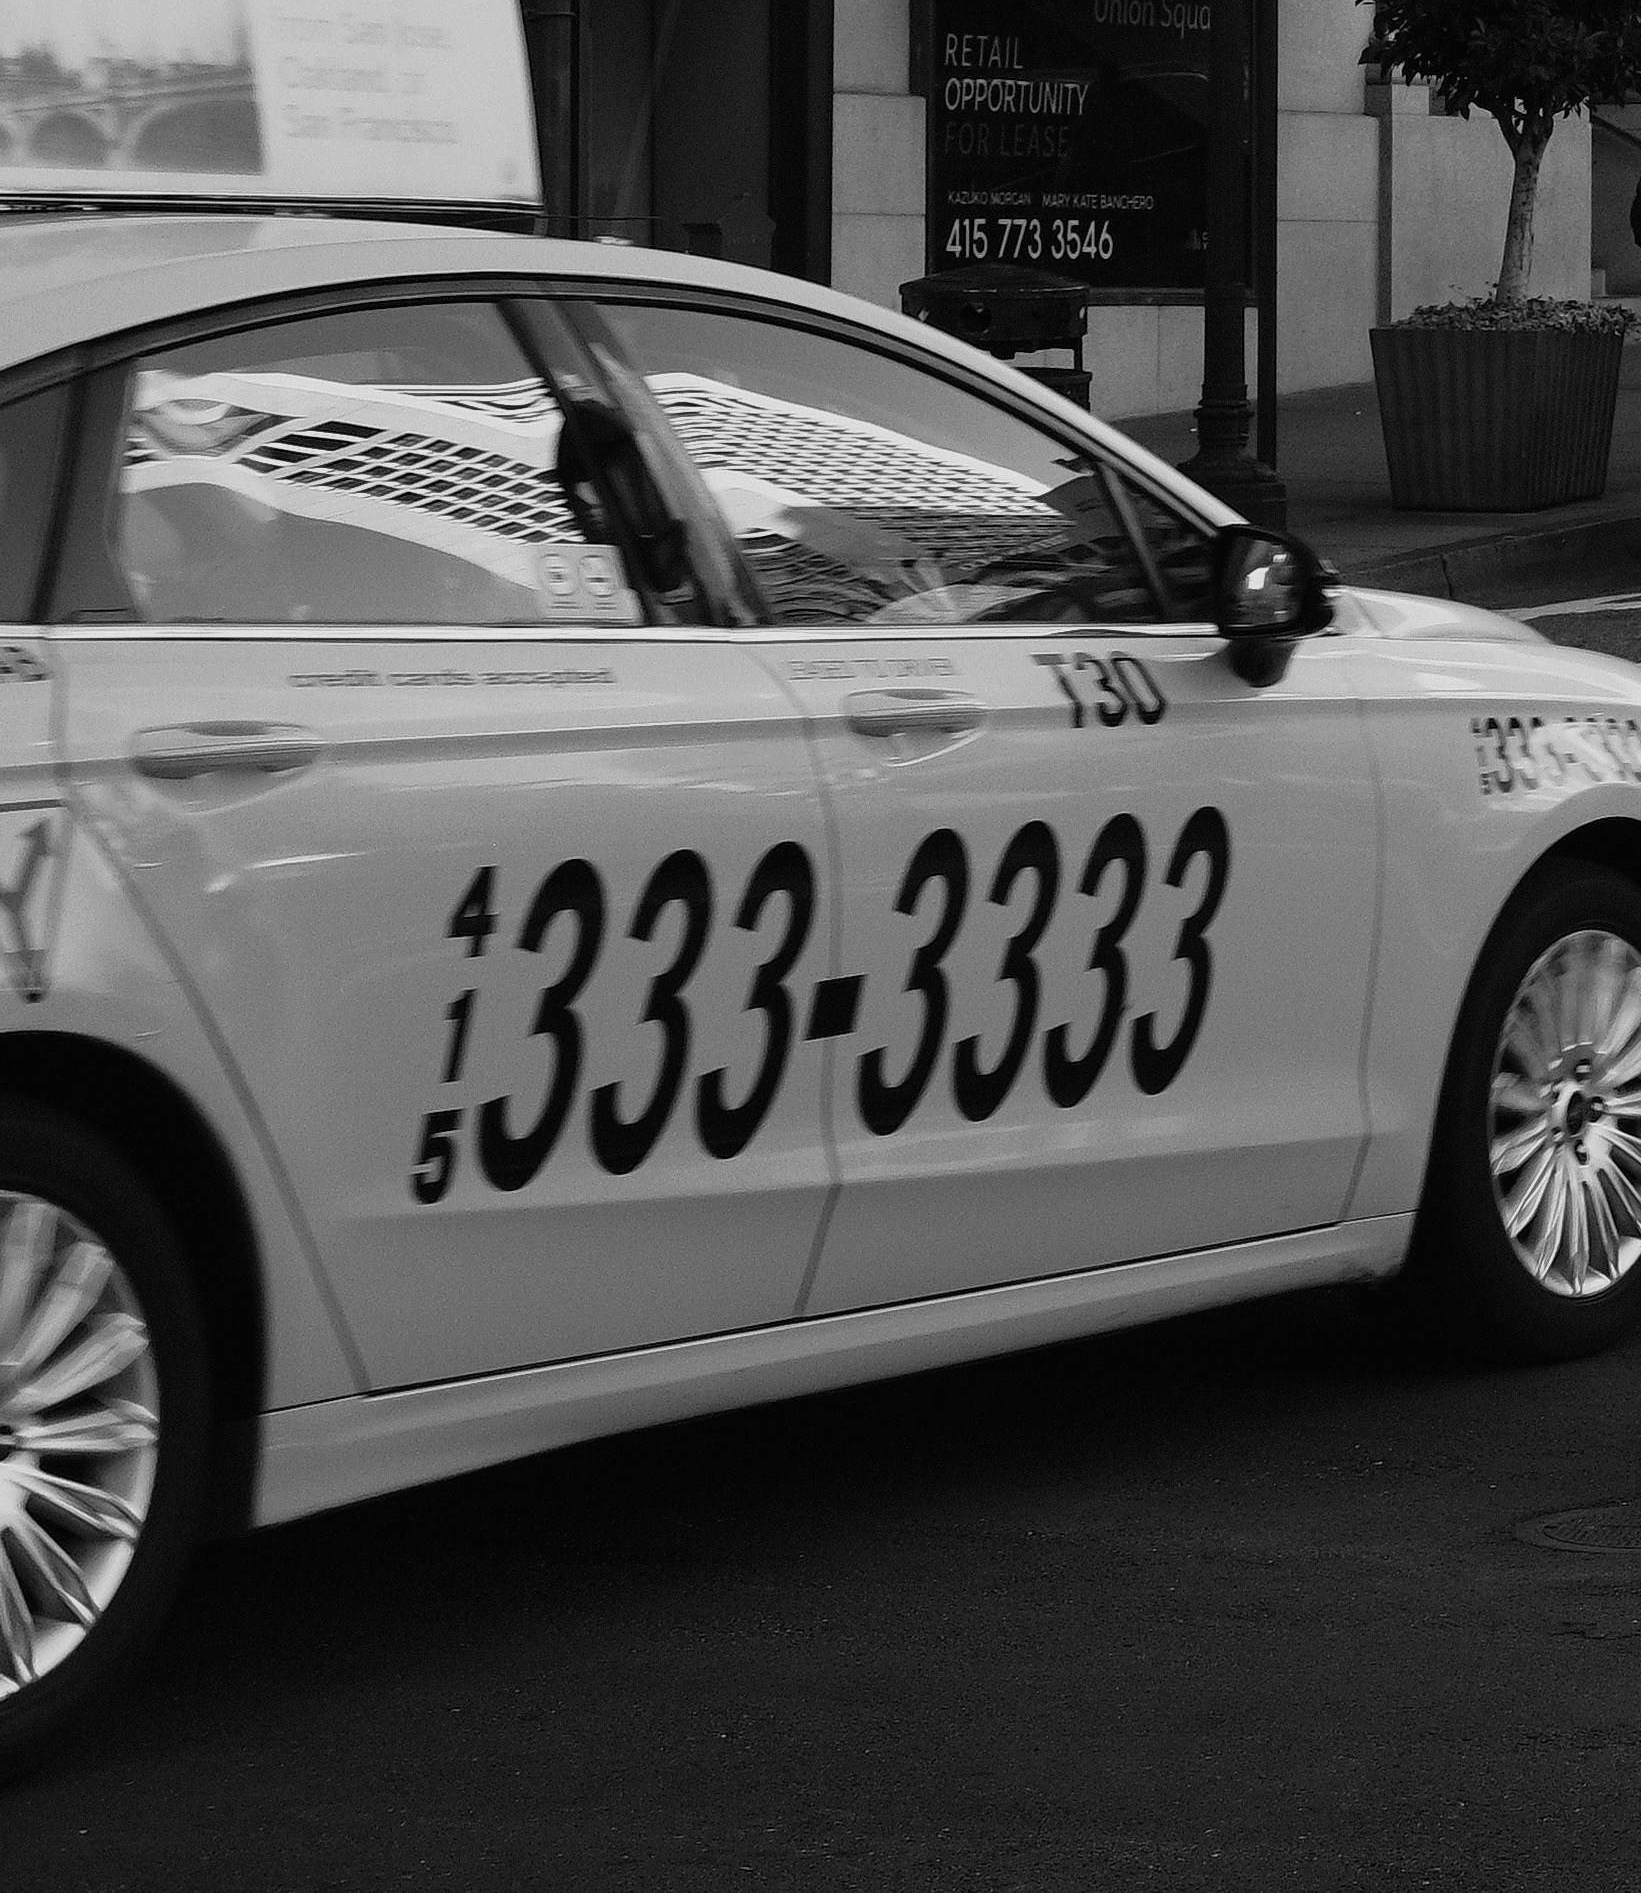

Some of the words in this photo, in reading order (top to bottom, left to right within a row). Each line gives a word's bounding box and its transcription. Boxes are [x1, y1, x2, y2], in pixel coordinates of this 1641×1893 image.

[945, 33, 1024, 69] RETAIL
[945, 78, 1089, 115] OPPORTUNITY
[946, 122, 990, 155] FOR
[999, 123, 1070, 157] LEASE
[1042, 192, 1071, 207] MARY
[1073, 193, 1098, 208] KATE
[945, 218, 988, 259] 415
[997, 218, 1043, 259] 773
[1051, 218, 1114, 259] 3546
[1030, 650, 1168, 729] T30
[478, 804, 1231, 1193] 333-3333
